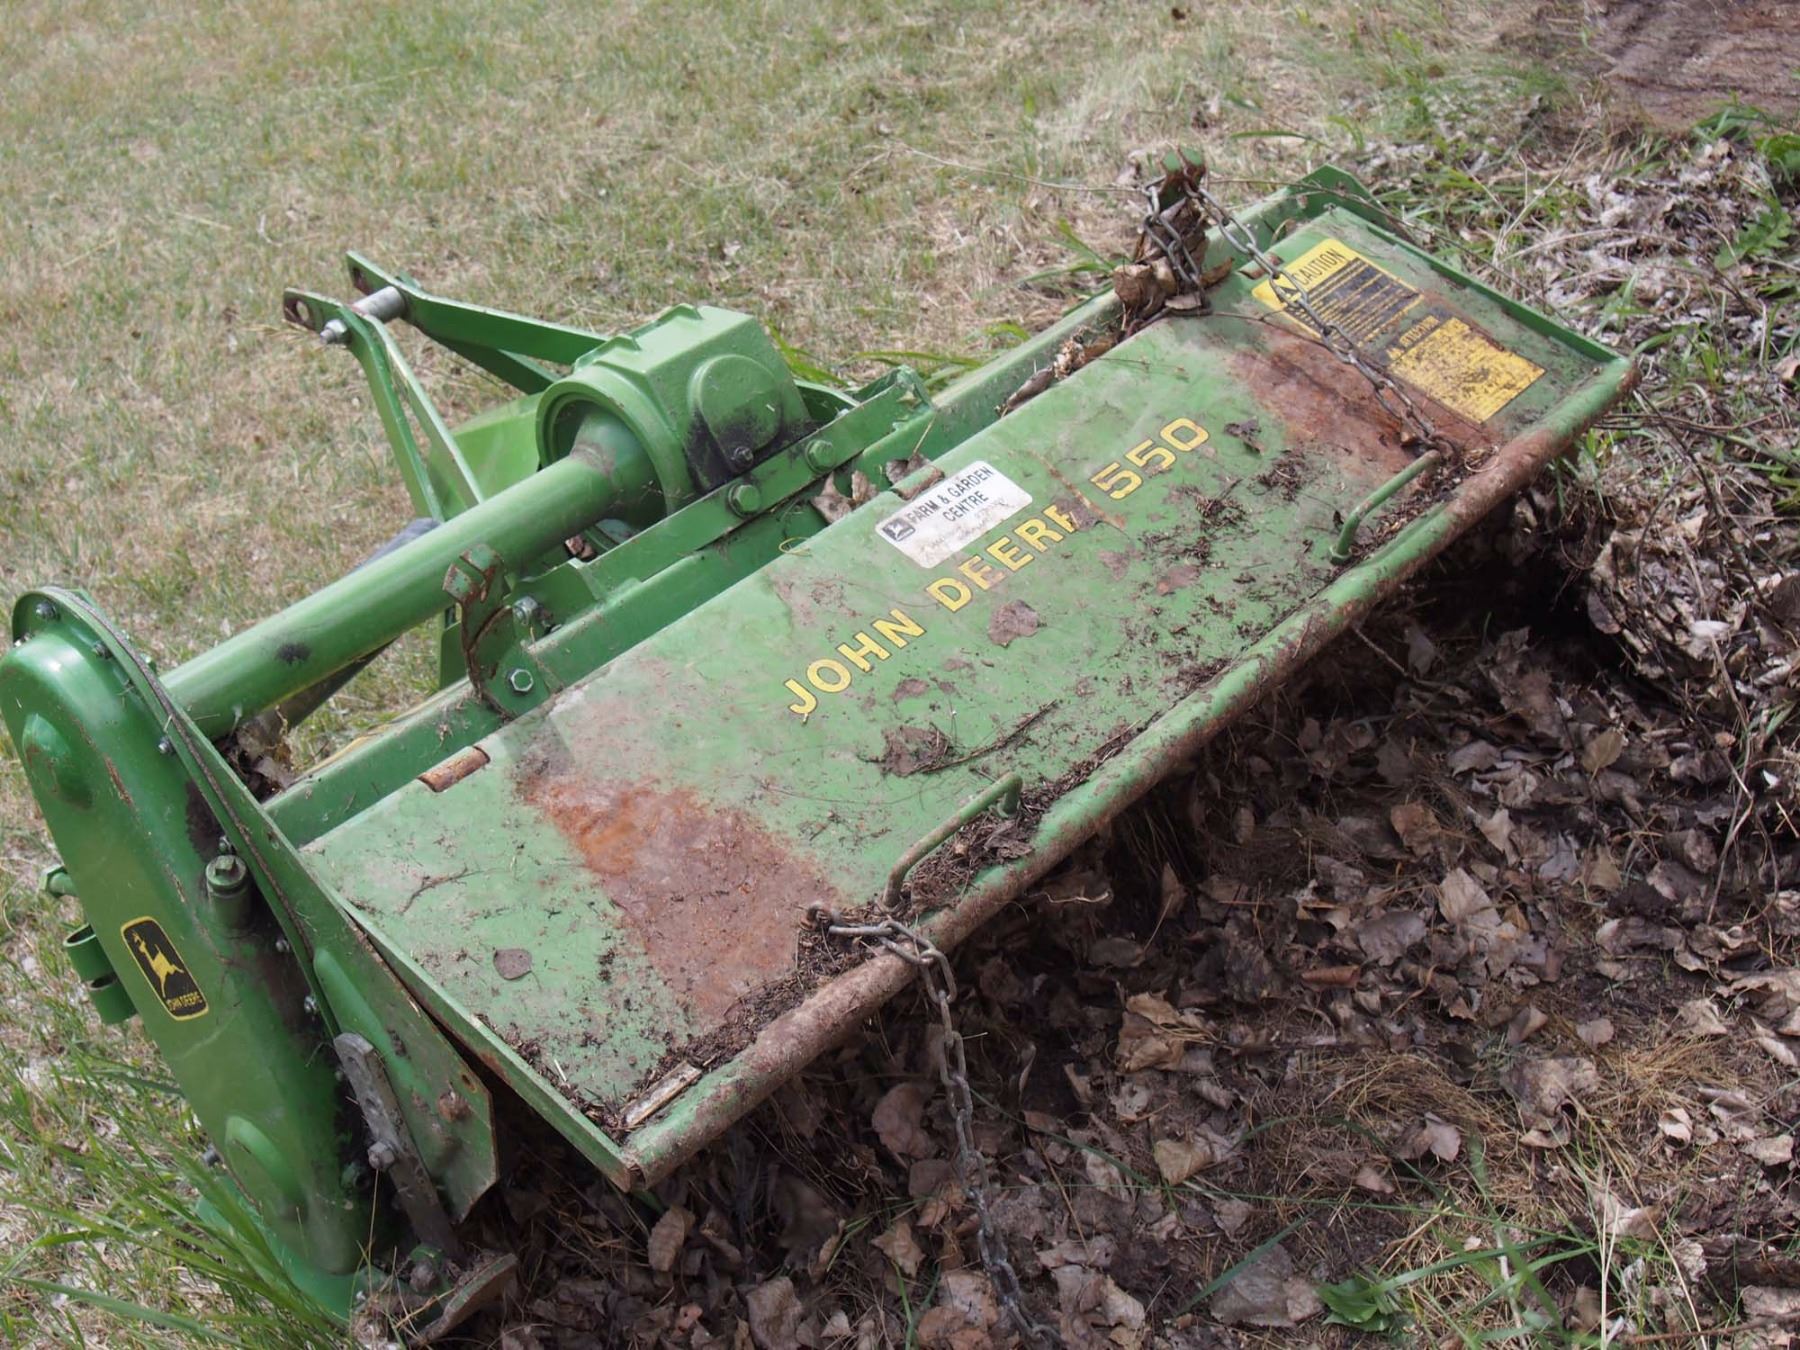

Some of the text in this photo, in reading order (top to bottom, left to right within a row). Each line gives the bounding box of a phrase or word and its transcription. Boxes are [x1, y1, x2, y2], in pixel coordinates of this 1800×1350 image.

[1291, 248, 1346, 285] CAUTION
[906, 466, 994, 525] FARM & GARDEN
[942, 490, 989, 522] CENTRE
[784, 608, 926, 715] JOHN
[1090, 418, 1210, 500] 550
